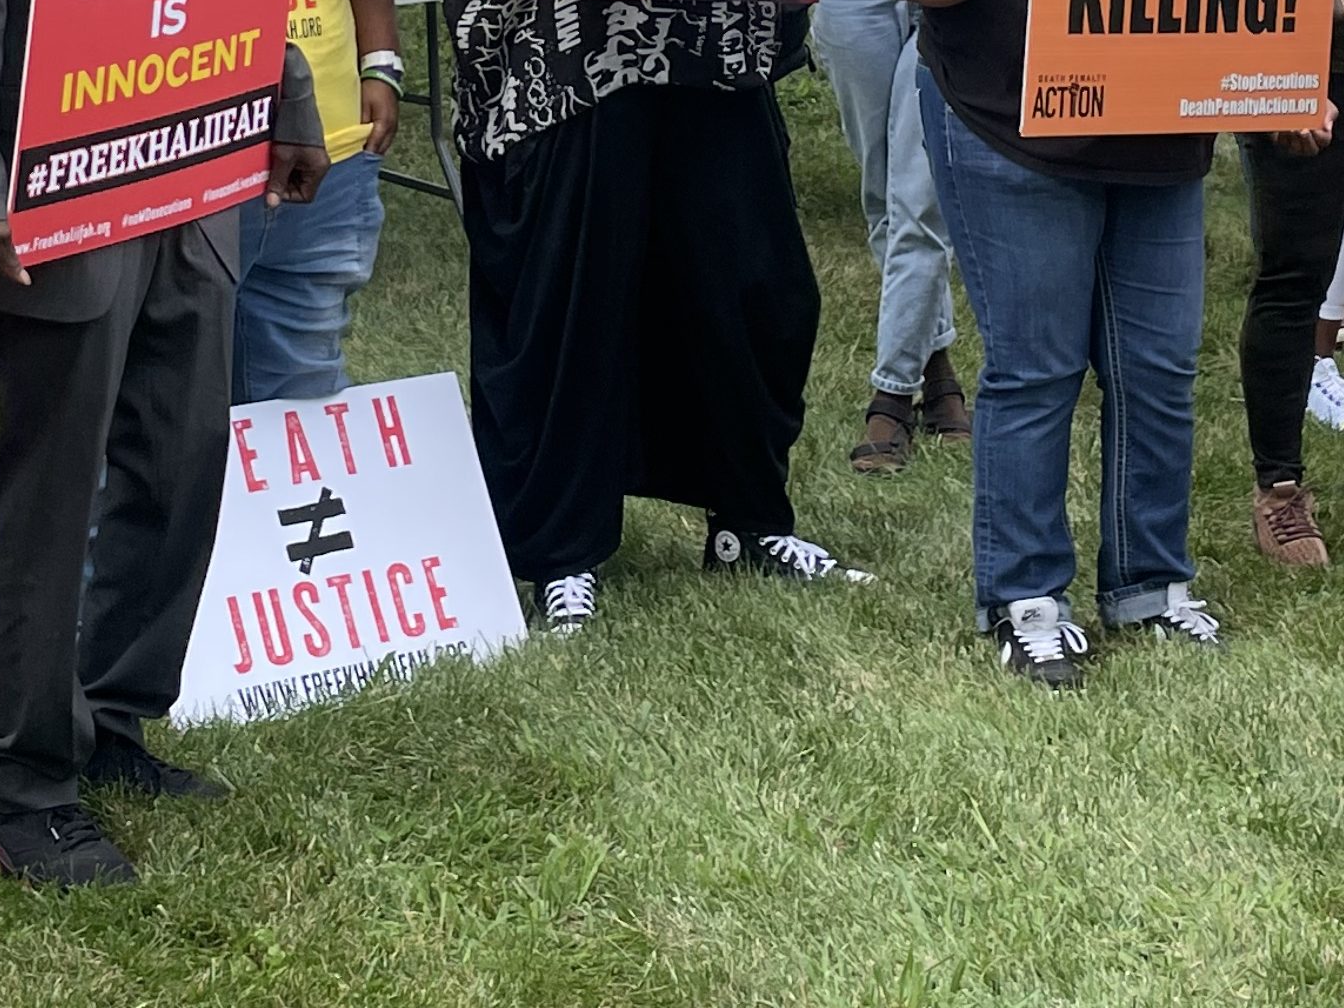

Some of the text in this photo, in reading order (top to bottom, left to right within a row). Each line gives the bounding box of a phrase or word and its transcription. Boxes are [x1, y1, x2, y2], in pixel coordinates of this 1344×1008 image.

[61, 29, 261, 113] INNOCENT
[1032, 82, 1105, 119] ACTION
[1180, 97, 1318, 118] DeathPenaltyAction.org
[1220, 72, 1320, 91] #StopExecutions
[27, 96, 272, 198] #FREEKHALIIFAH
[231, 395, 413, 493] EATH
[226, 556, 459, 674] JUSTICE
